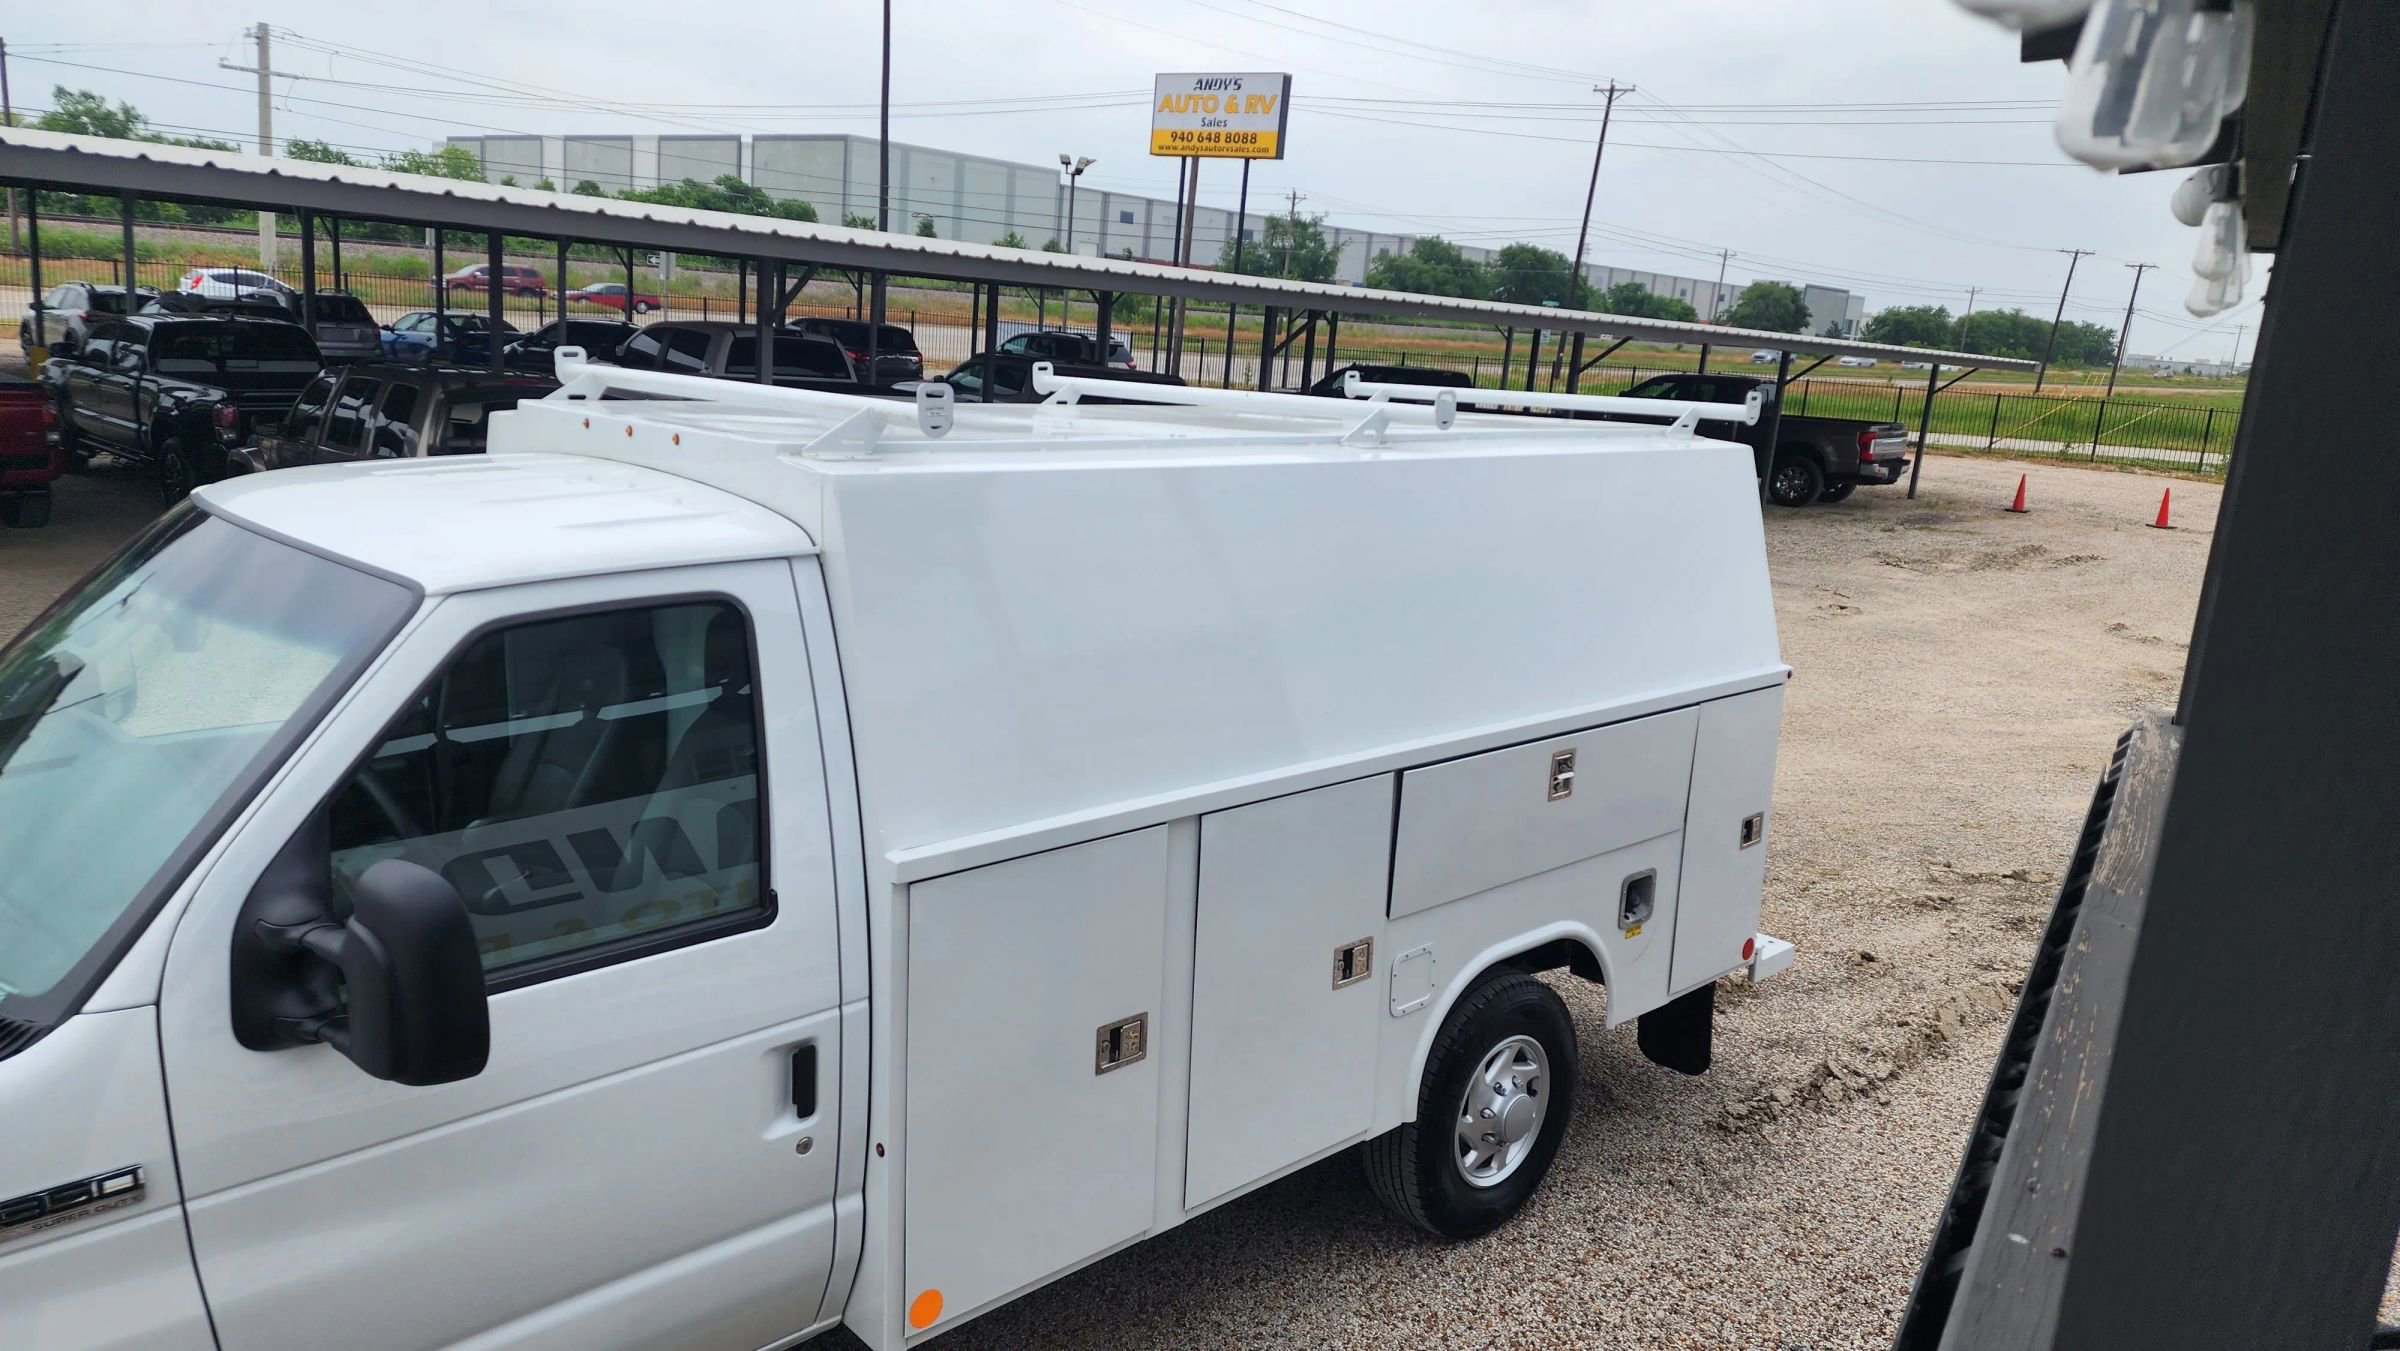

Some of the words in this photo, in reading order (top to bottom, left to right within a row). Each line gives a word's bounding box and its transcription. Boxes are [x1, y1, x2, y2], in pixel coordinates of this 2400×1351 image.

[1193, 76, 1243, 91] ANDY'S
[1158, 93, 1220, 113] AUTO
[1224, 95, 1240, 114] &
[1244, 95, 1279, 114] RV
[1200, 117, 1228, 128] Sales
[1170, 131, 1194, 143] 940
[1197, 132, 1221, 144] 648
[1224, 132, 1258, 144] 8088
[1158, 143, 1270, 155] www.andysautorvsales.com
